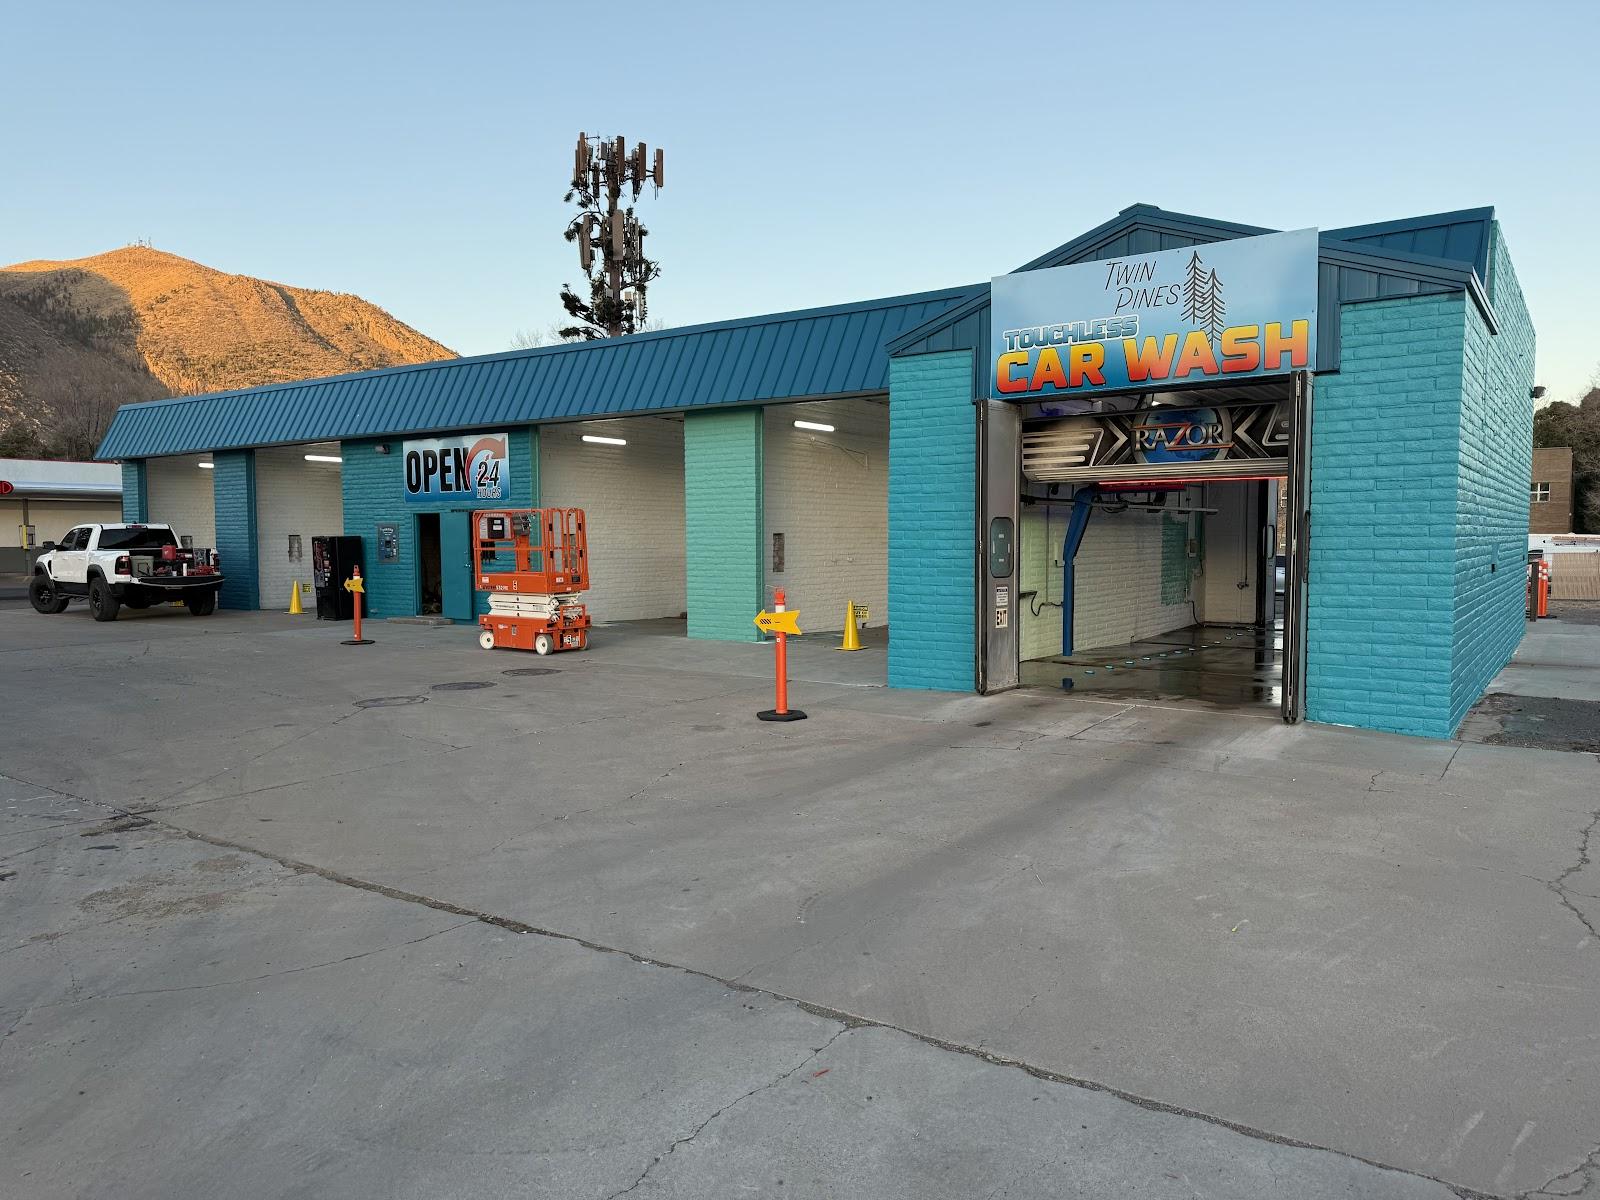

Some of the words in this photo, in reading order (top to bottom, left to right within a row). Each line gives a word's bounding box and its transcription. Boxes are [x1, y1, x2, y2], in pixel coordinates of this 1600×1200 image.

[1105, 261, 1156, 290] TWIN
[1114, 284, 1180, 315] PINES
[1003, 315, 1139, 352] TOUCHLESS
[997, 342, 1106, 394] CAR
[1123, 320, 1309, 382] WASH
[1132, 423, 1231, 451] RAZOR
[406, 447, 471, 494] OPEN
[477, 460, 500, 487] 24
